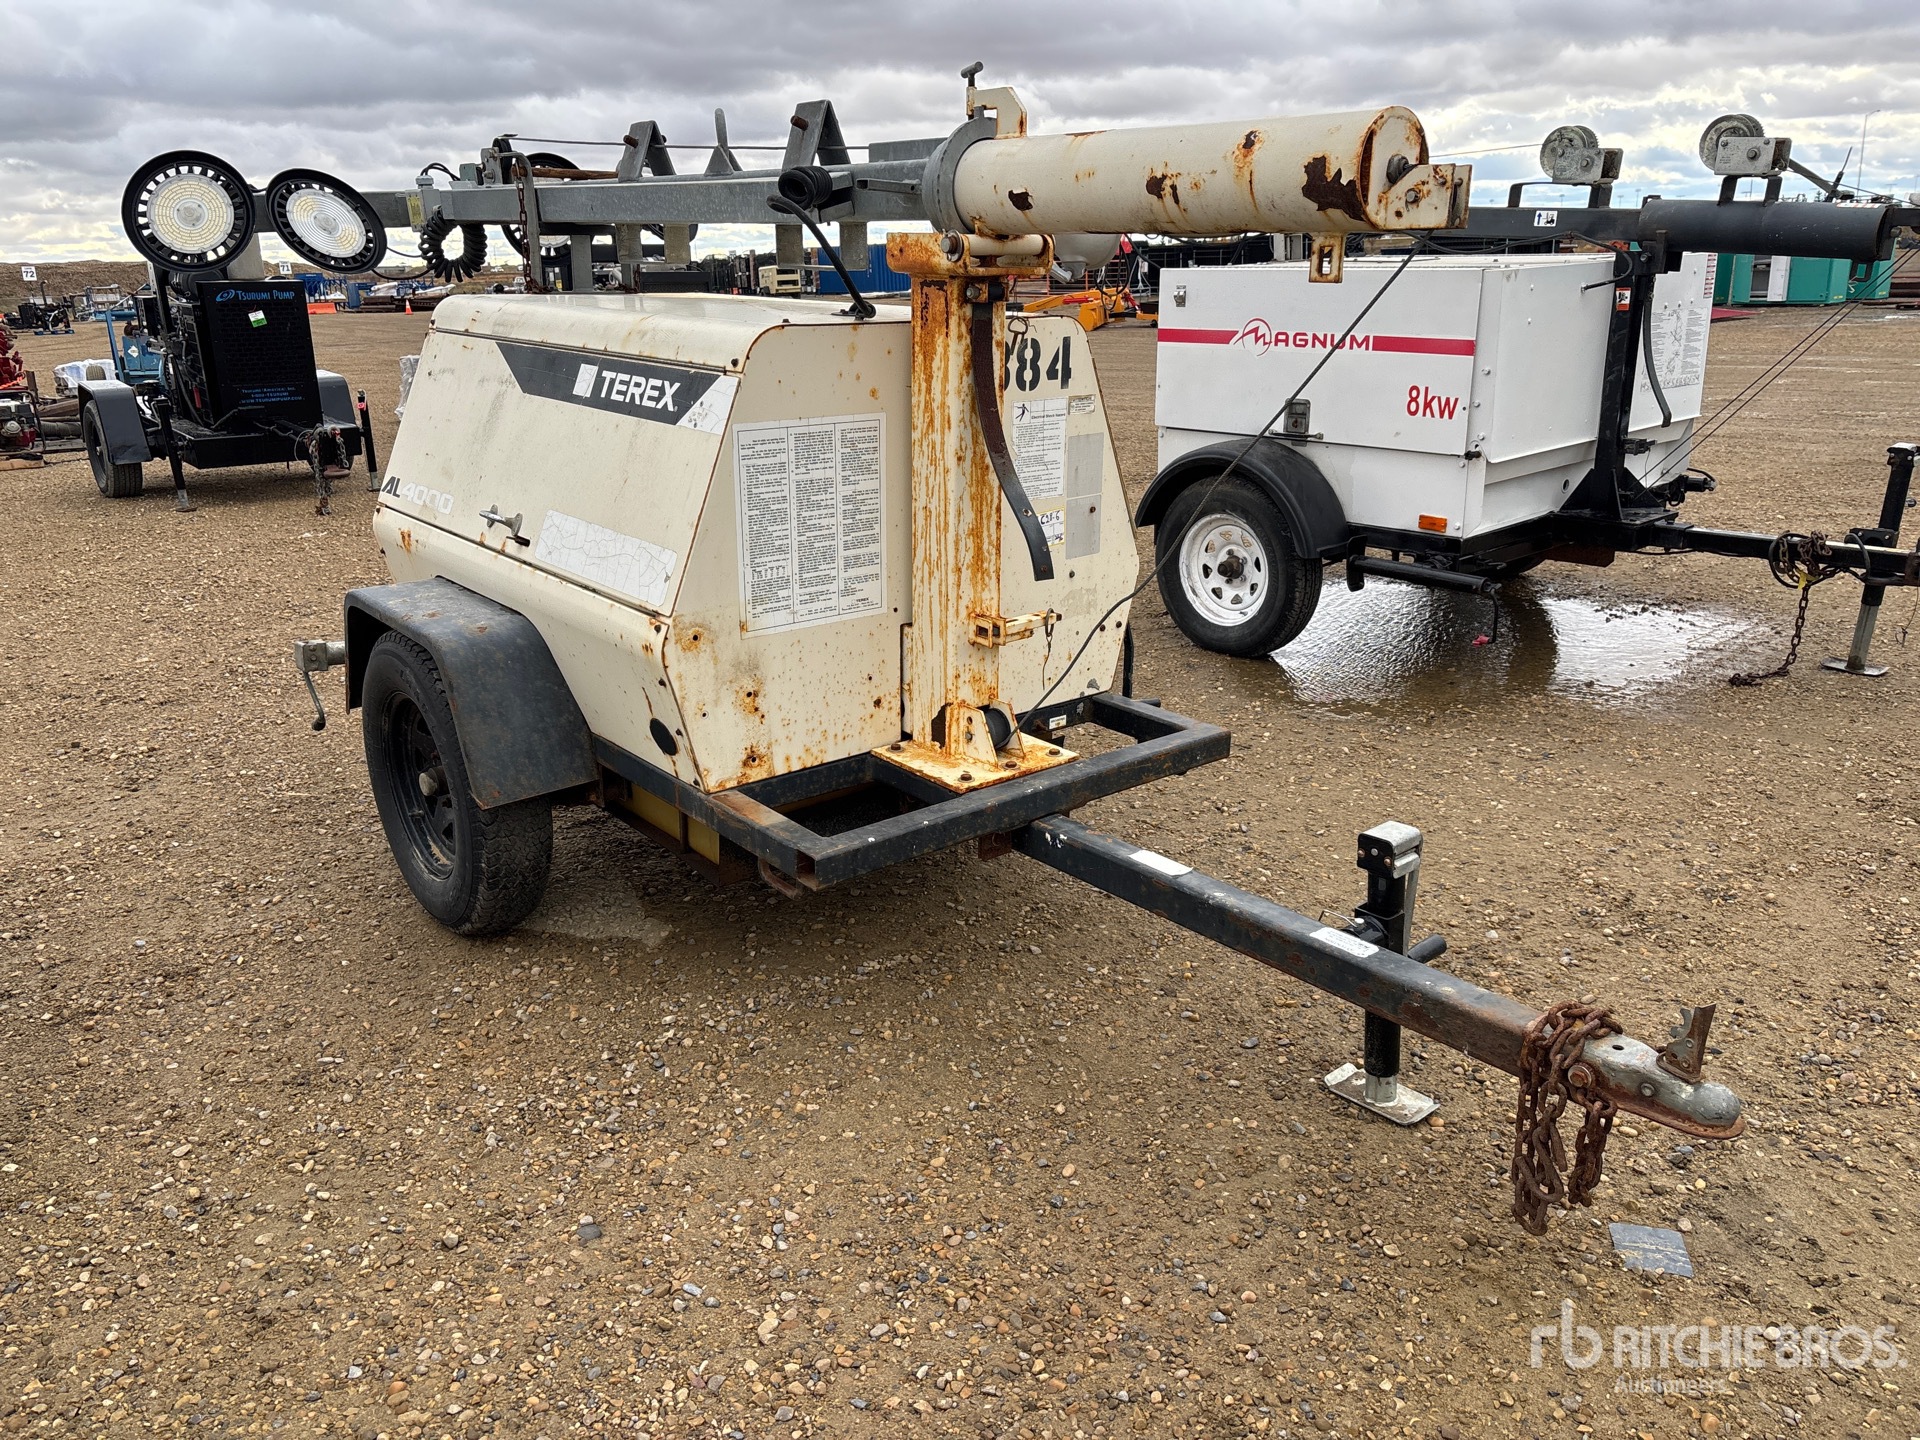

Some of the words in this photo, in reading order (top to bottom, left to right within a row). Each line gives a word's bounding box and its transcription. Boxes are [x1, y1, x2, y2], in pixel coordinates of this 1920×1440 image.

[23, 270, 36, 278] 72
[280, 264, 291, 272] 71
[272, 289, 295, 300] PUMP
[1234, 319, 1370, 355] MAGNUM
[1004, 336, 1072, 393] 84
[600, 369, 681, 412] TEREX
